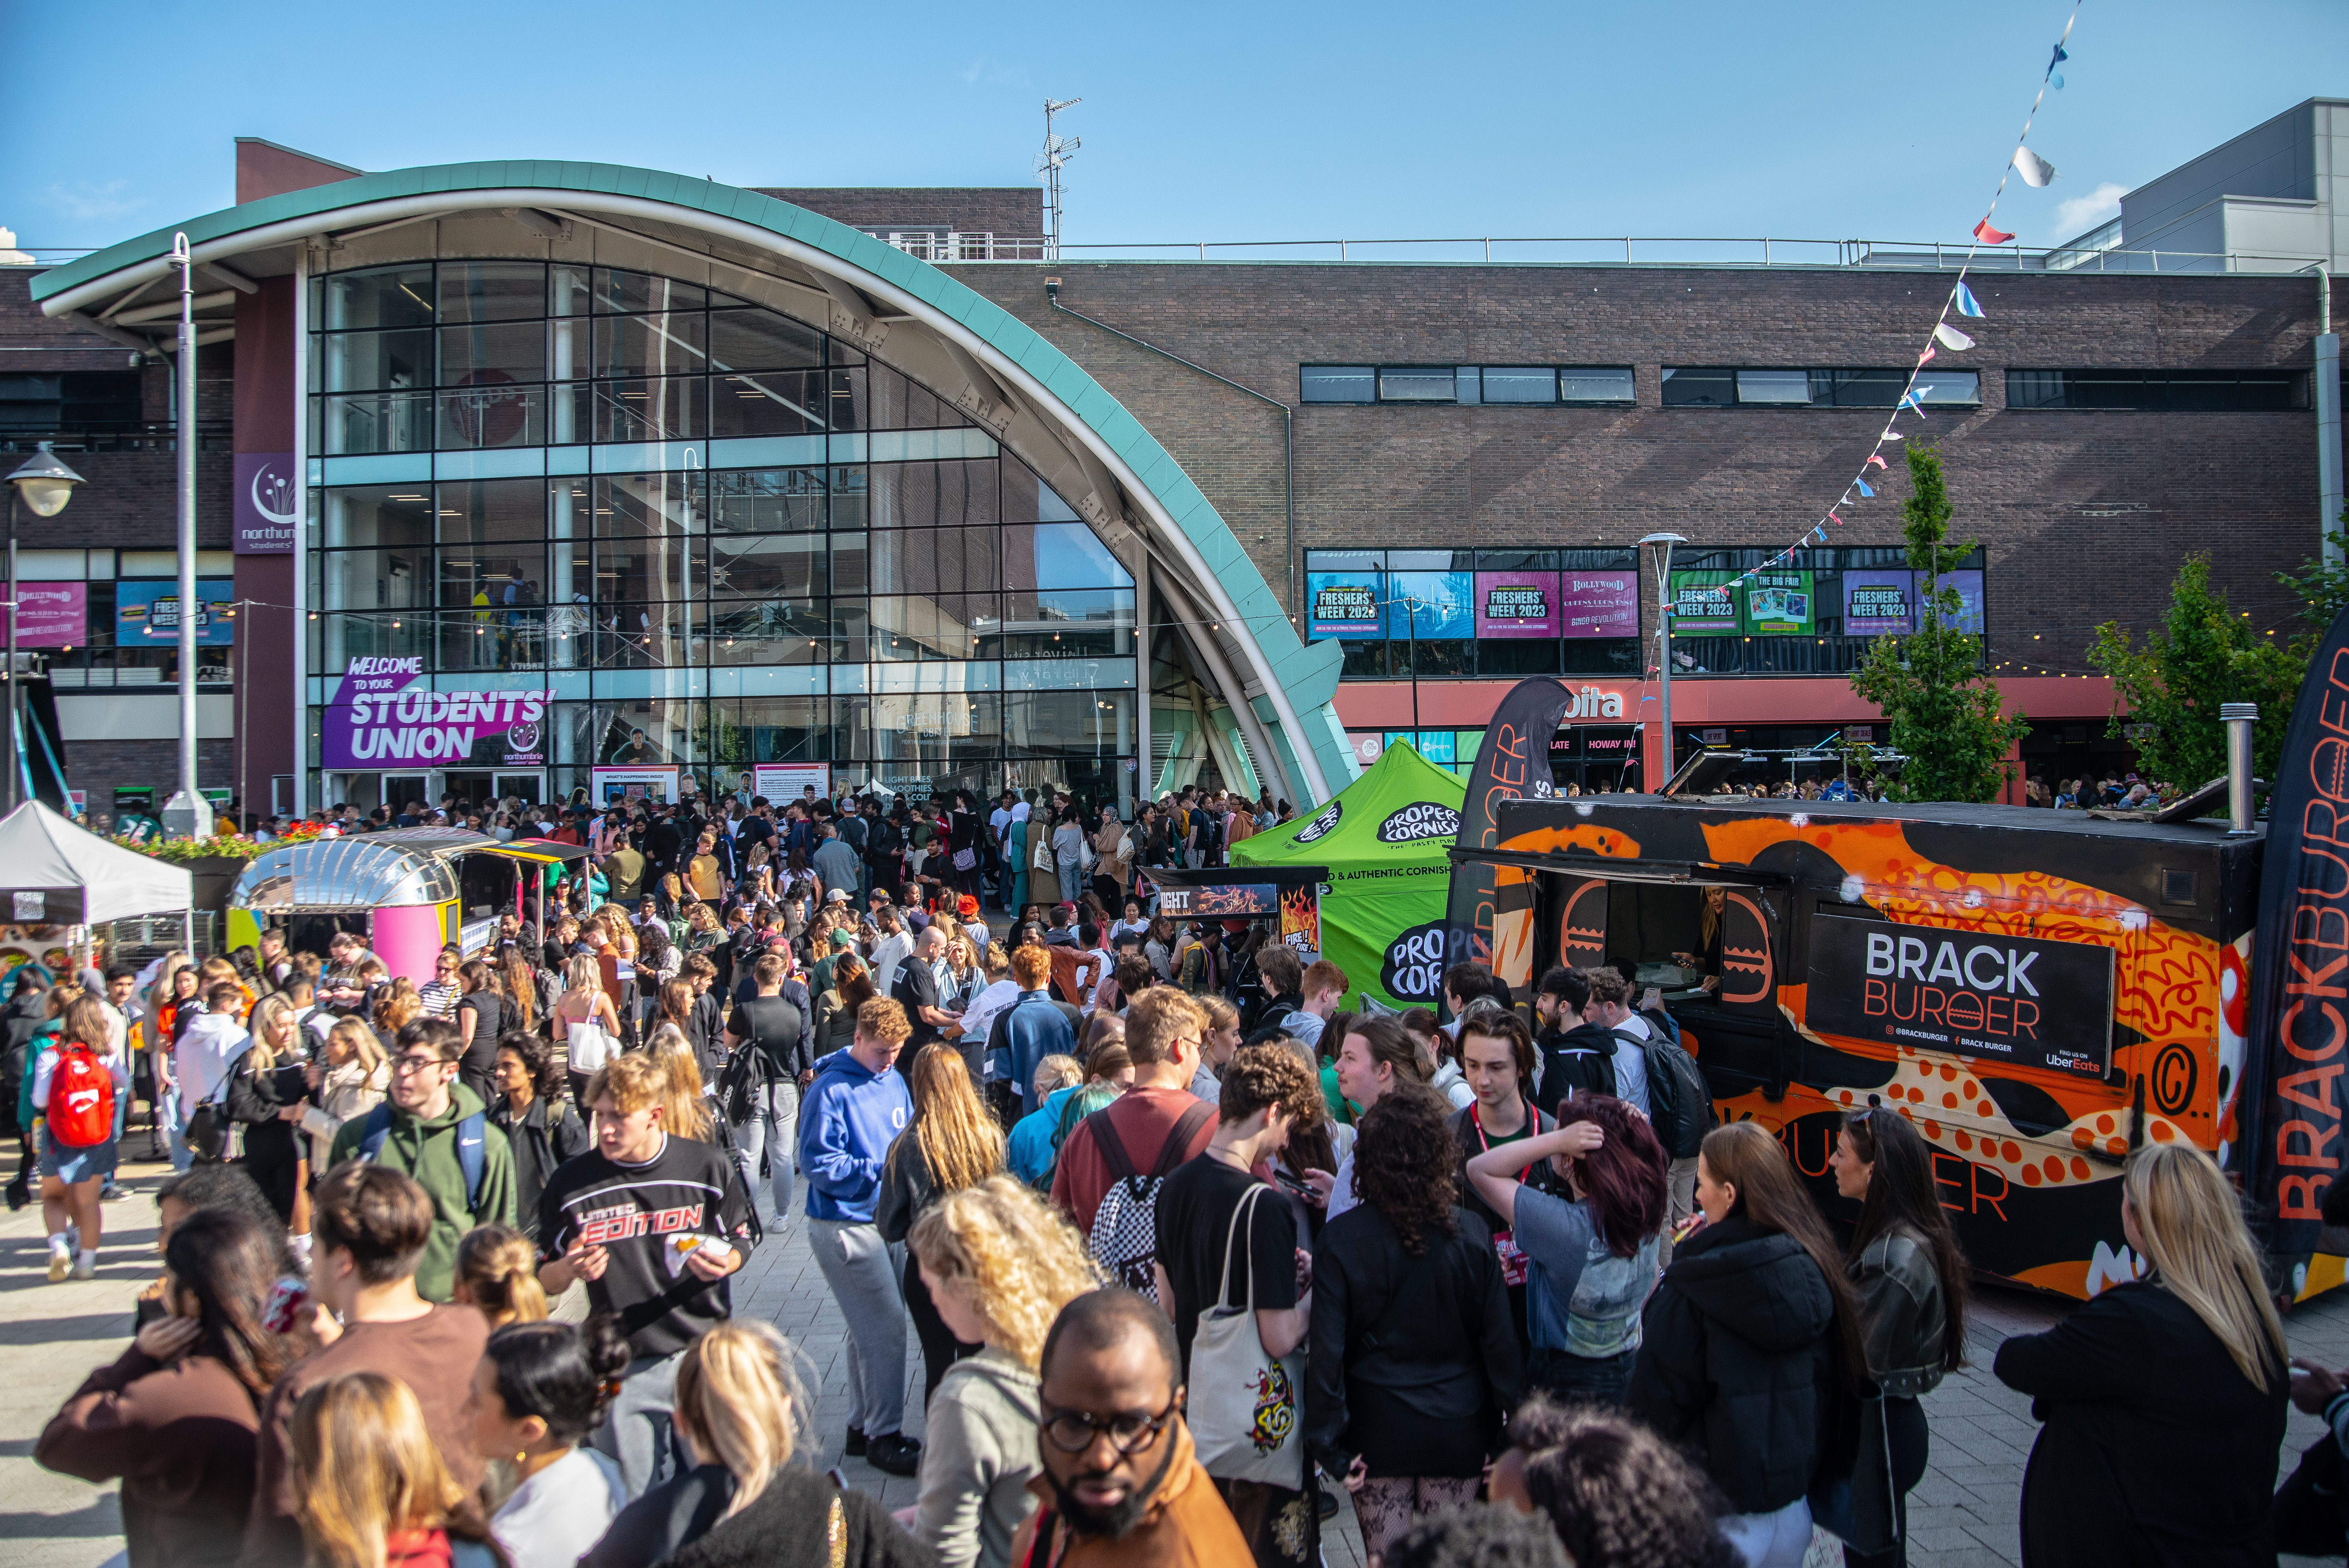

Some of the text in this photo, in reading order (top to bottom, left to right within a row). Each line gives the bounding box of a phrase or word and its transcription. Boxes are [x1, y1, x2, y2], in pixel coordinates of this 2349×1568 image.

[1573, 580, 1624, 592] BOLLYWOOD
[1759, 577, 1799, 586] THE BIG FAIR
[1320, 593, 1372, 605] FRESHERS’
[1491, 592, 1542, 604] FRESHERS’
[1853, 591, 1902, 603] FRESHERS’
[1317, 606, 1375, 618] WEEK 2023
[1489, 605, 1545, 617] WEEK 2023
[1677, 603, 1732, 615] WEEK 2023
[1852, 604, 1906, 616] WEEK 2023
[1572, 613, 1627, 626] BINGO REVOLUTION
[349, 657, 423, 676] WELCOME
[353, 679, 394, 690] TO YOUR
[895, 711, 979, 734] GREENHOUSE
[923, 727, 953, 737] COFFEE
[351, 726, 475, 759] UNION
[1550, 741, 1570, 749] LATE
[1589, 740, 1621, 749] HOWAY
[1385, 805, 1459, 832] PROPER
[1386, 820, 1460, 841] CORNISH
[1338, 872, 1345, 881] &
[1347, 868, 1404, 880] AUTHENTIC
[1406, 866, 1451, 876] CORNISH
[1295, 942, 1314, 953] FIRE!
[1866, 933, 2040, 997] BRACK
[1864, 978, 2040, 1040] BURGER
[1896, 1028, 1948, 1042] @BRACKBURGER
[1961, 1038, 2012, 1052] BRACK BURGER
[577, 1202, 636, 1224] LIMITED
[584, 1203, 704, 1245] EDITION
